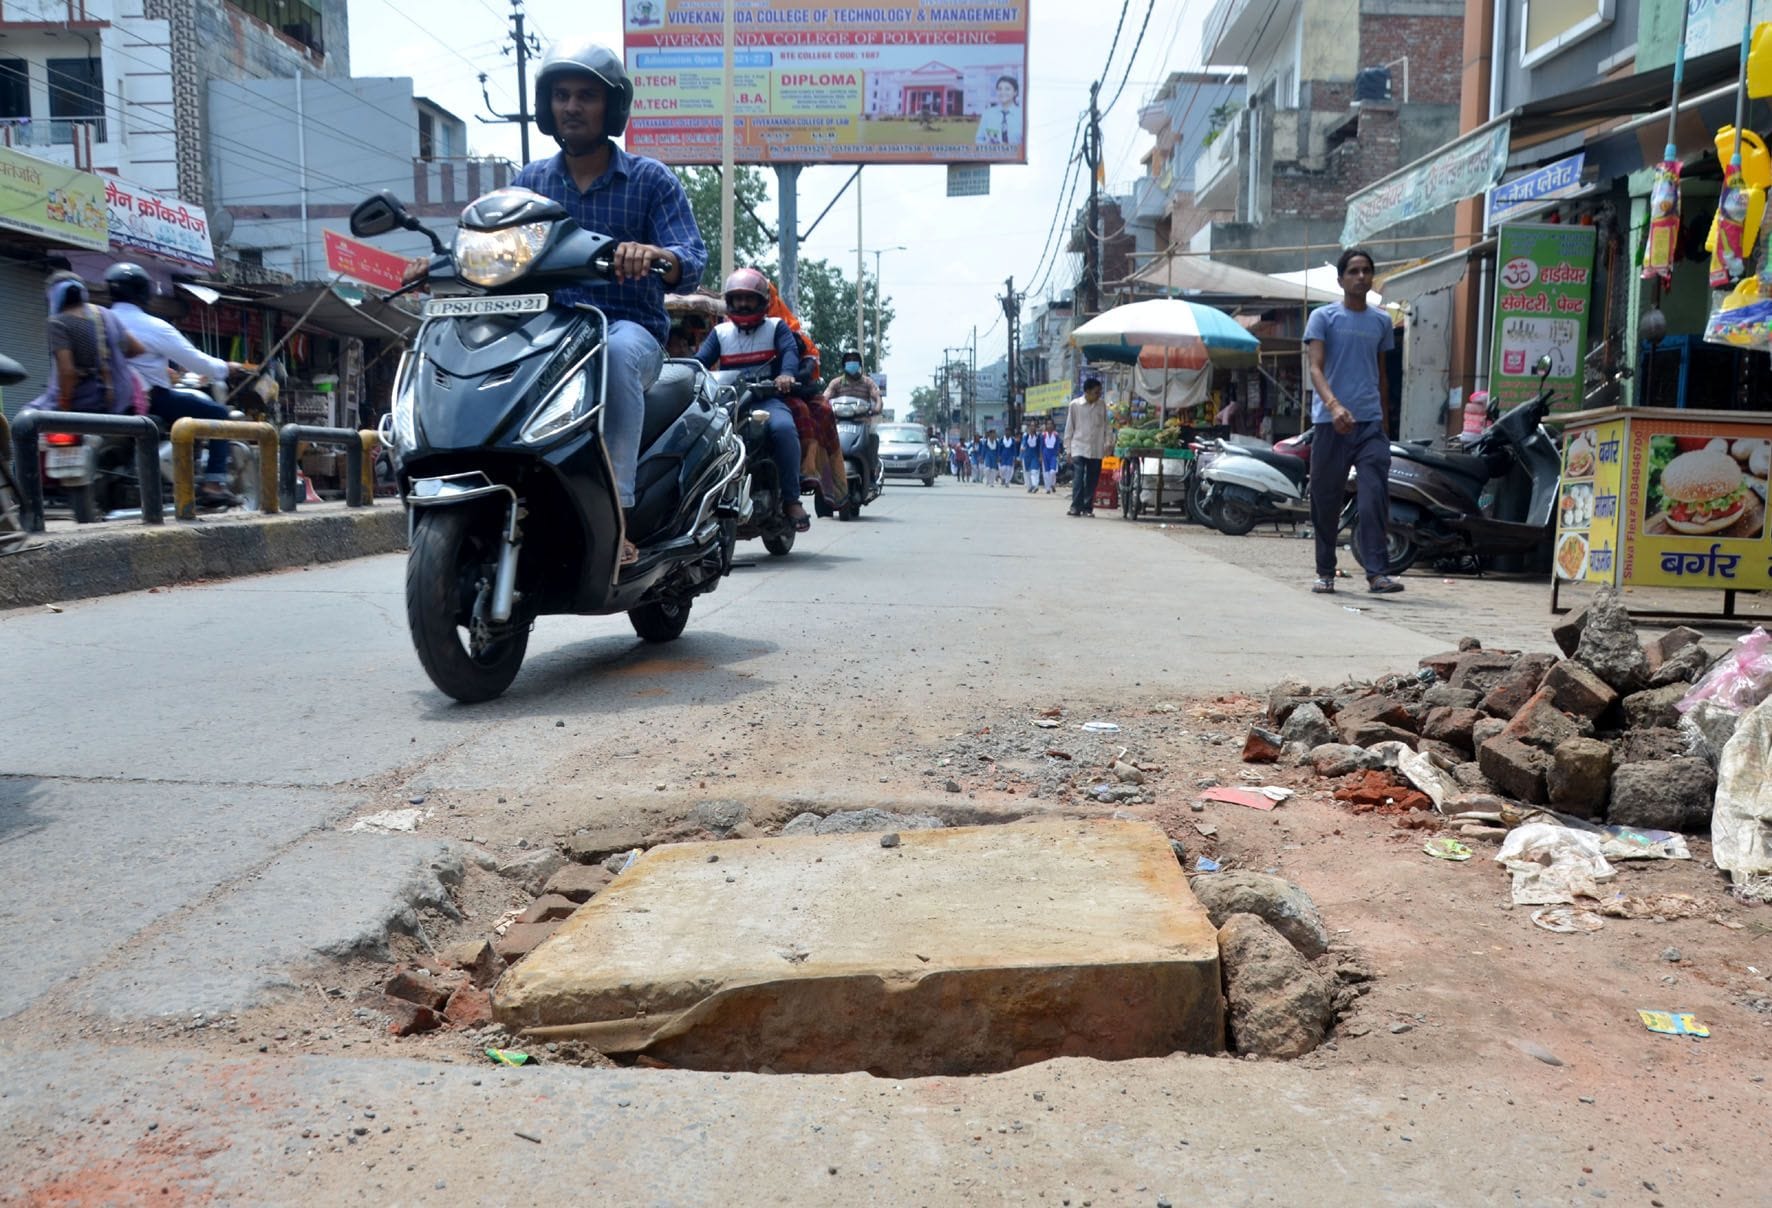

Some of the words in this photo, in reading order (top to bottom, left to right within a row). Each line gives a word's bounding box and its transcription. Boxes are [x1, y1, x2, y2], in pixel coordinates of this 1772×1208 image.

[668, 10, 752, 24] VIVEKANDA
[757, 9, 809, 23] COLLEGE
[813, 9, 829, 22] OF
[834, 8, 912, 22] TECHNOLOGY
[917, 9, 926, 21] &
[931, 8, 1019, 21] MANAGEMENT
[654, 33, 768, 47] VIVEKANNDA
[773, 32, 850, 45] COLLEGE
[855, 32, 878, 45] OF
[882, 31, 997, 45] POLYTECHNIC
[797, 51, 832, 60] COLLEGE
[634, 75, 677, 87] B.TECH
[781, 74, 857, 87] DIPLOMA
[633, 98, 678, 110] M.TECH
[733, 93, 767, 104] .B.A.
[797, 118, 824, 126] COLLEGE
[105, 181, 132, 211] जैन
[1623, 545, 1635, 579] Shiva
[1660, 544, 1742, 578] बर्गर
